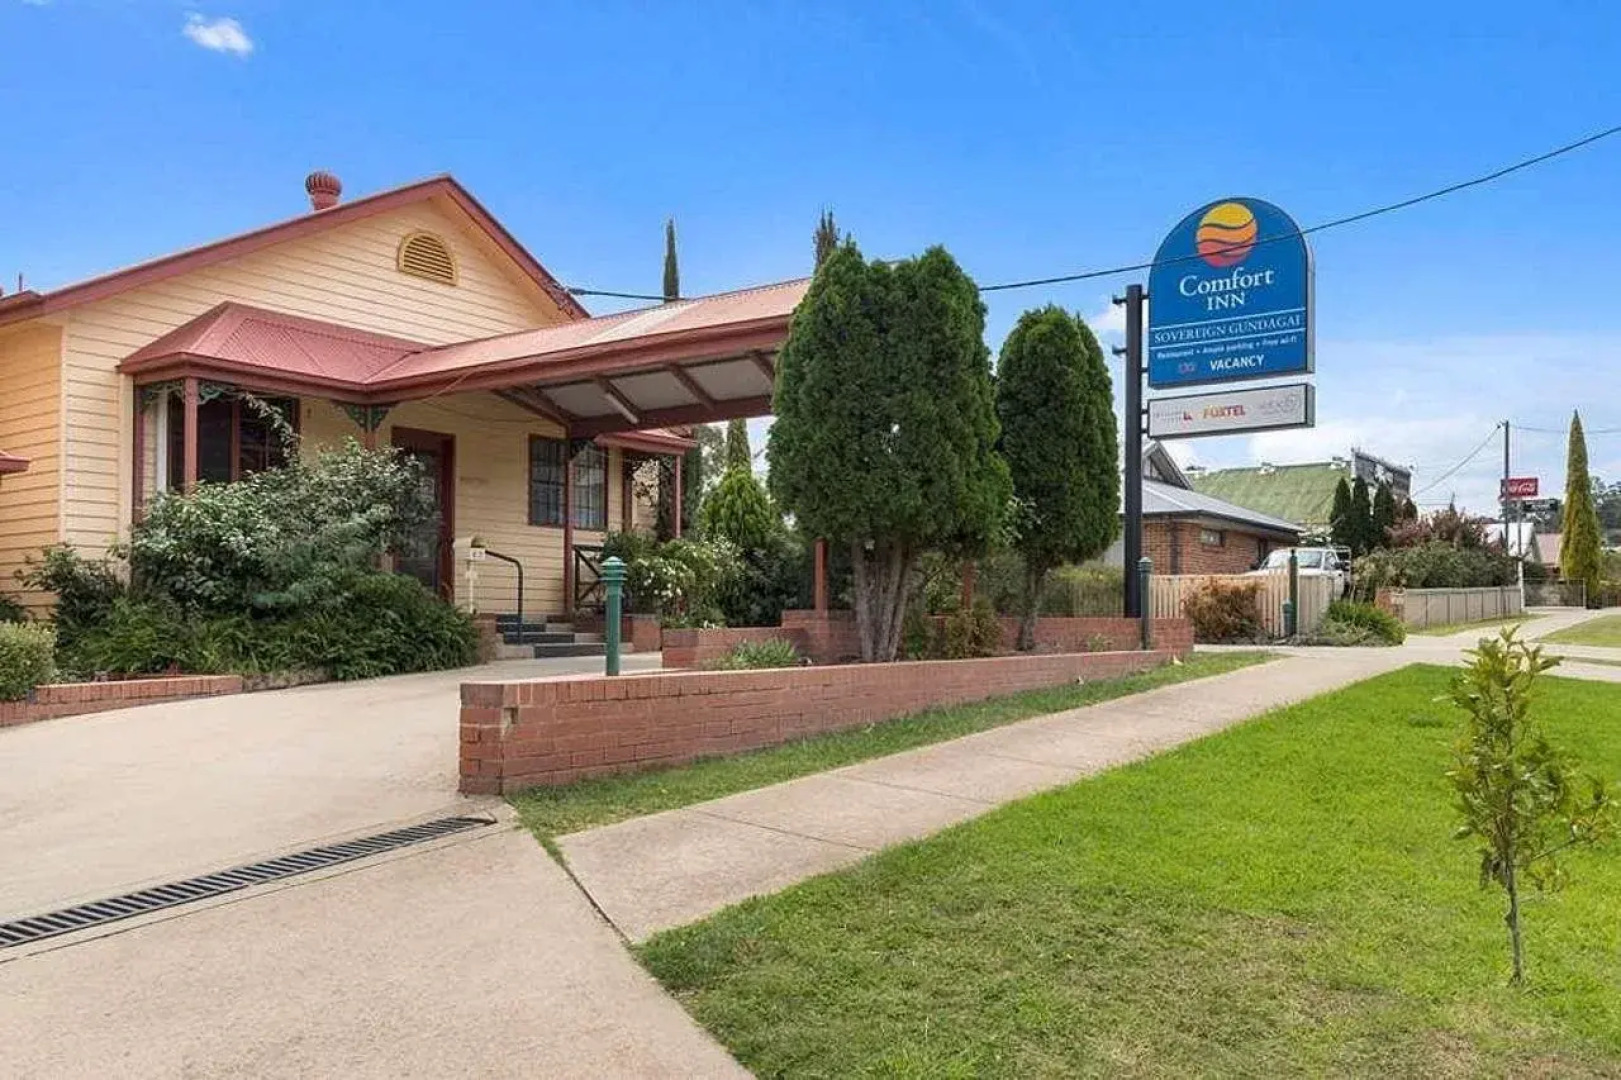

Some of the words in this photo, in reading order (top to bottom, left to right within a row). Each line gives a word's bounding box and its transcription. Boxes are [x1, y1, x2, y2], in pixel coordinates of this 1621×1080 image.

[1179, 266, 1274, 297] Comfort
[1207, 292, 1245, 310] INN
[1154, 324, 1226, 343] SOVEREIGN
[1229, 314, 1300, 334] GUNDAGAI
[1210, 354, 1264, 371] VACANCY
[1203, 404, 1246, 419] FOXTEL
